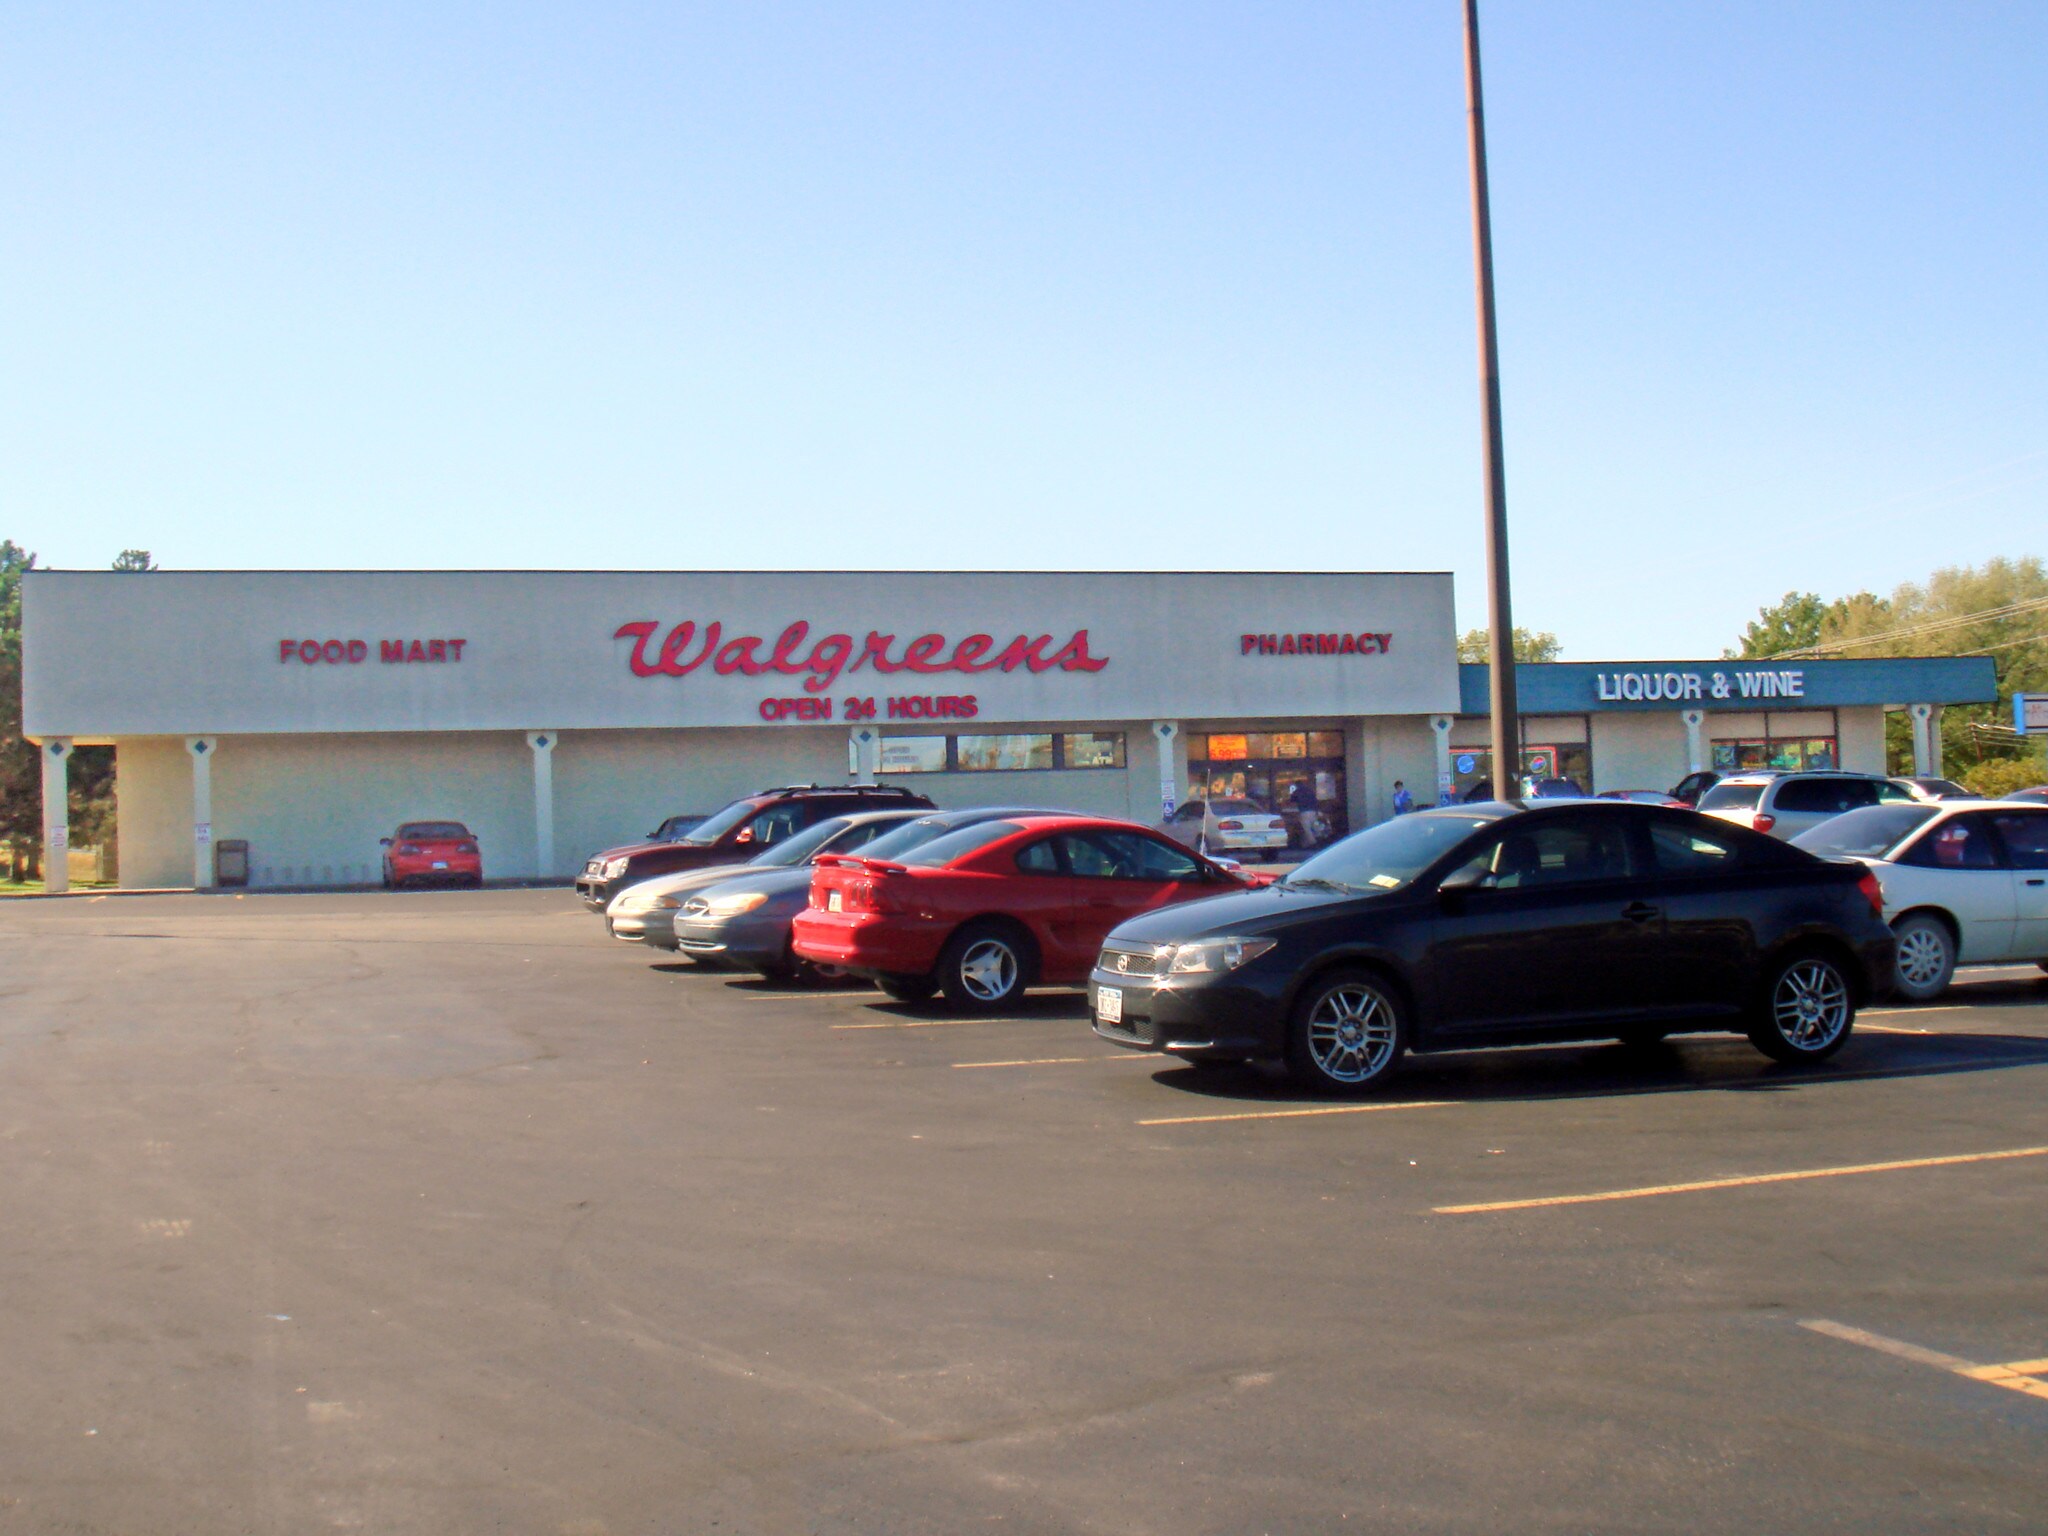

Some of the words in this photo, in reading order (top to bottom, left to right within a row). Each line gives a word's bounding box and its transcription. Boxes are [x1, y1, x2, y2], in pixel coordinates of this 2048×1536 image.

[280, 640, 367, 664] FOOD
[382, 639, 467, 663] MART
[614, 621, 1109, 694] Walgreens
[1241, 633, 1392, 656] PHARMACY
[1597, 673, 1702, 701] LIQUOR
[1711, 672, 1730, 699] &
[1735, 671, 1804, 698] WINE
[759, 697, 833, 721] OPEN
[846, 697, 877, 720] 24
[889, 695, 979, 720] HOURS
